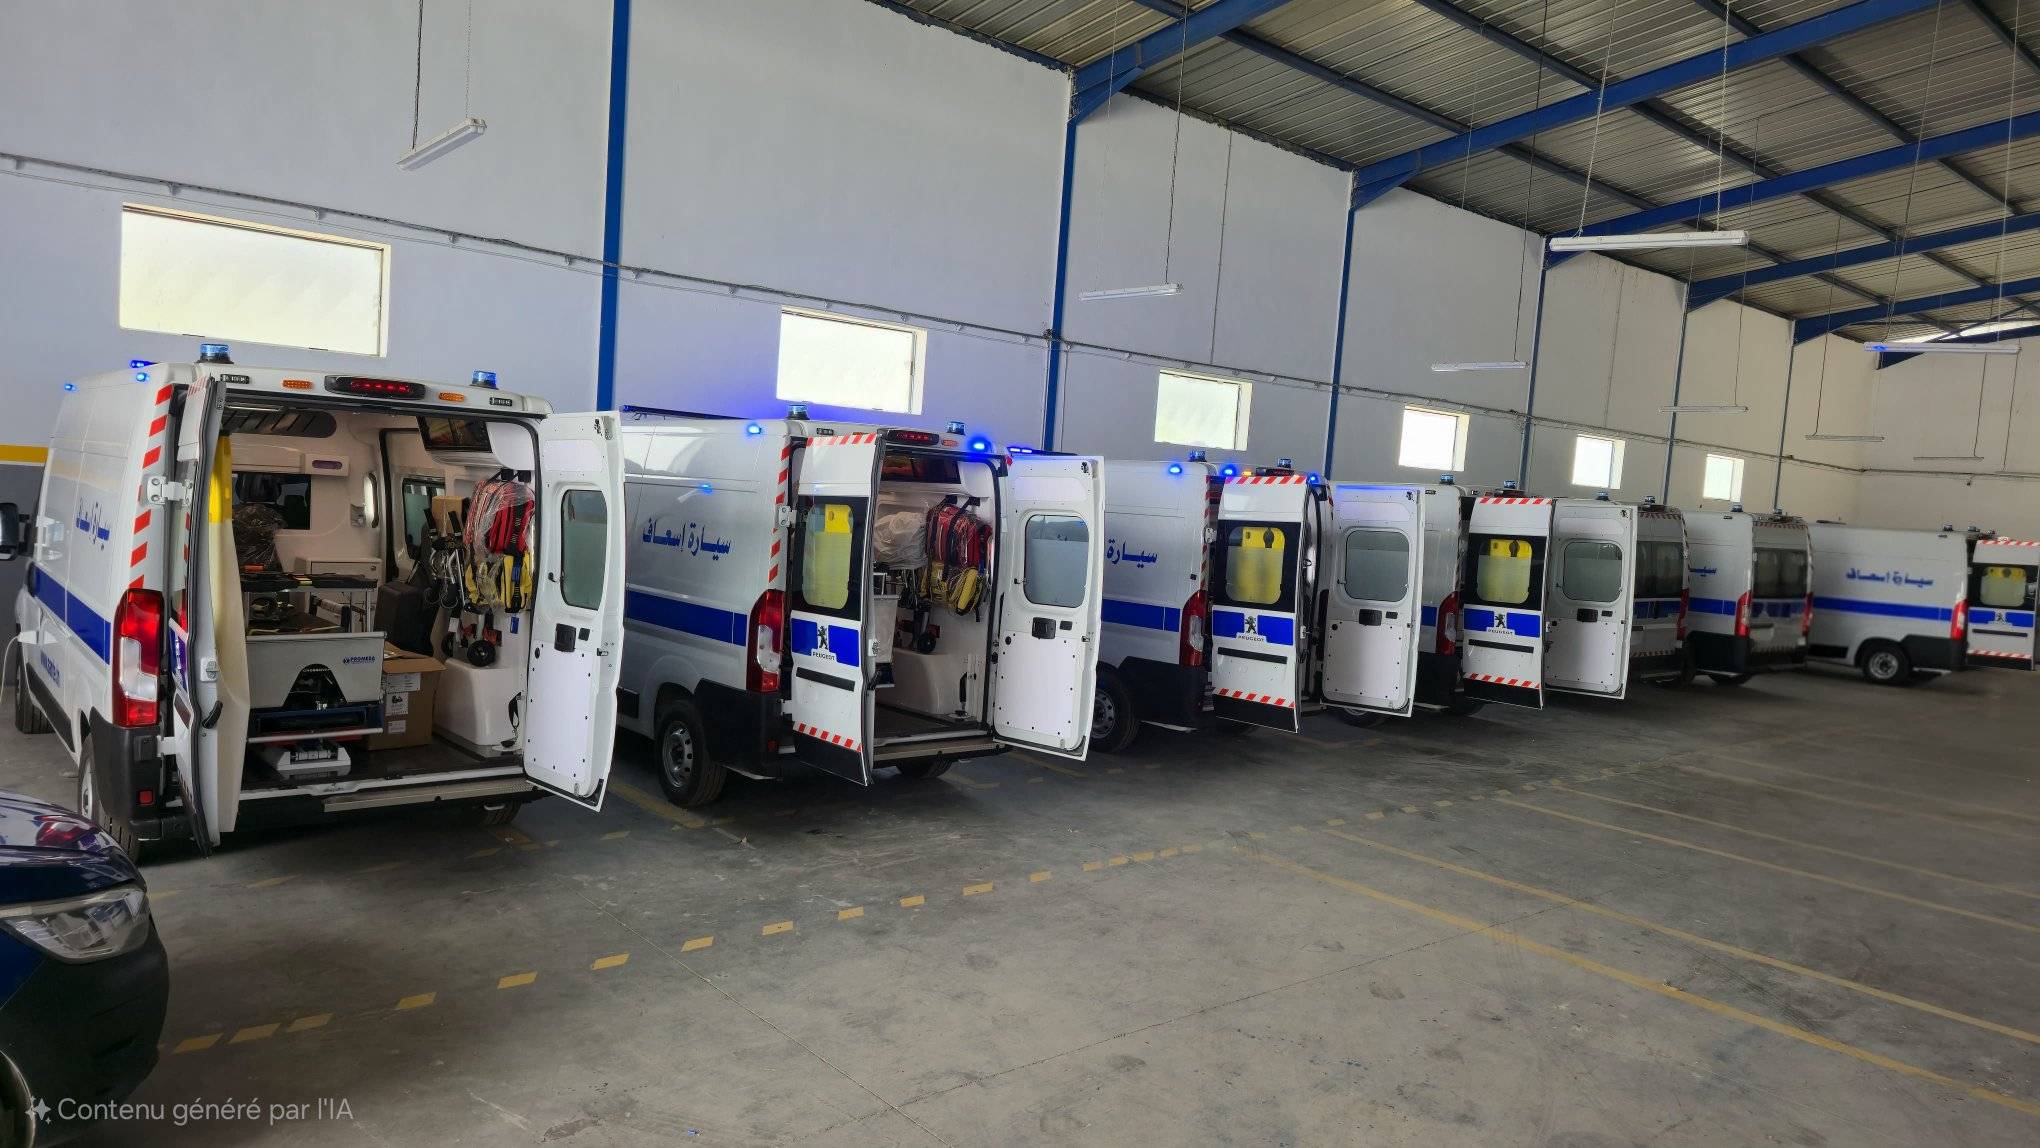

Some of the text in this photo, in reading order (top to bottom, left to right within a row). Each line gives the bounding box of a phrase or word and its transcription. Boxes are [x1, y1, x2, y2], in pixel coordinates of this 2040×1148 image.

[642, 517, 732, 561] سيارة إسعاف
[1106, 538, 1158, 569] سيارة
